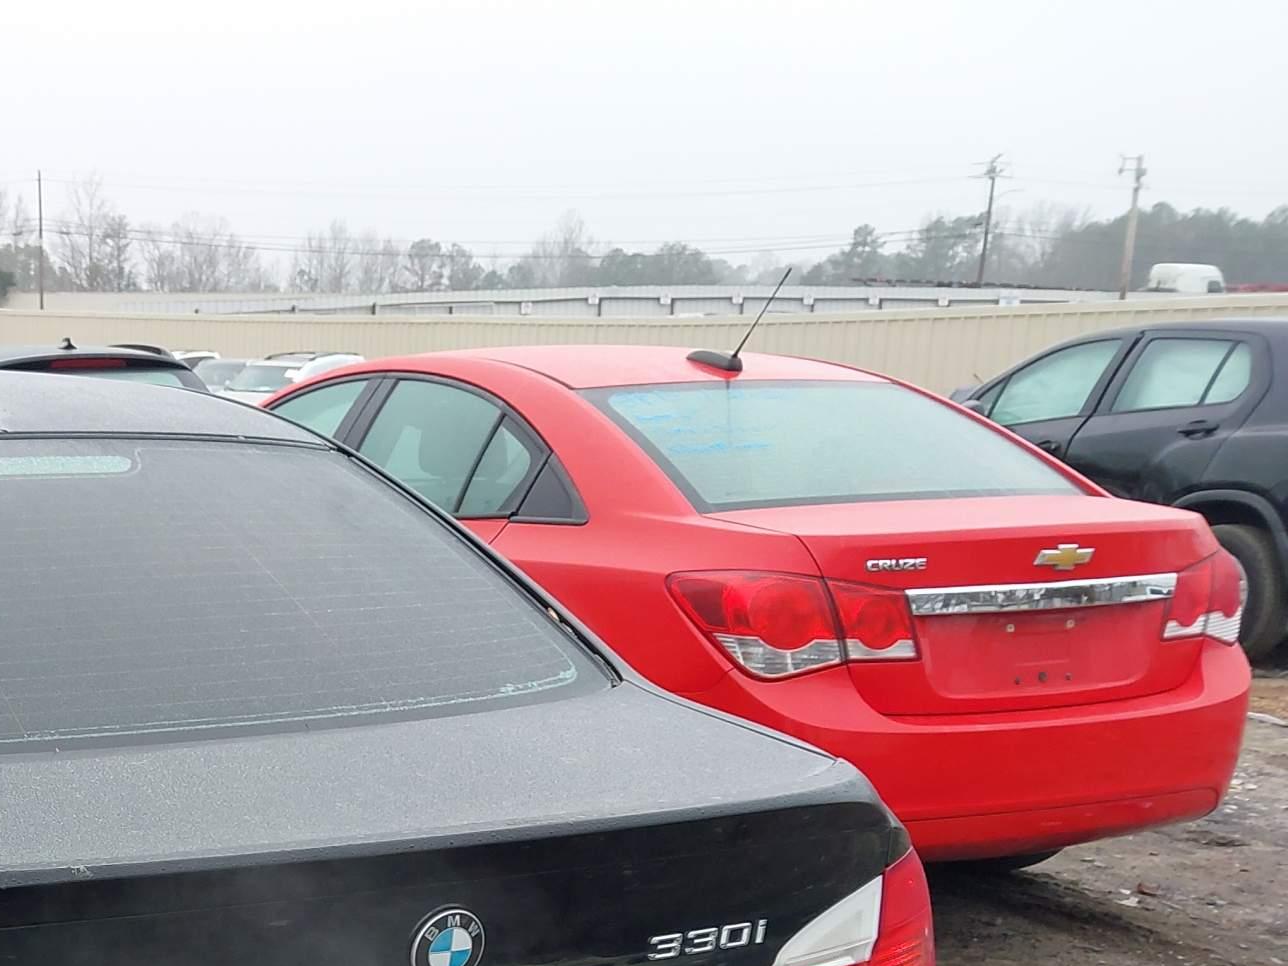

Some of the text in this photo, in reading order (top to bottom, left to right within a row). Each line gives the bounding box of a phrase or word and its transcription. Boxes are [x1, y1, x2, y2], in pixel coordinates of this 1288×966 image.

[866, 557, 928, 573] CRUZE
[424, 914, 480, 941] BMW
[648, 919, 768, 961] 330i
